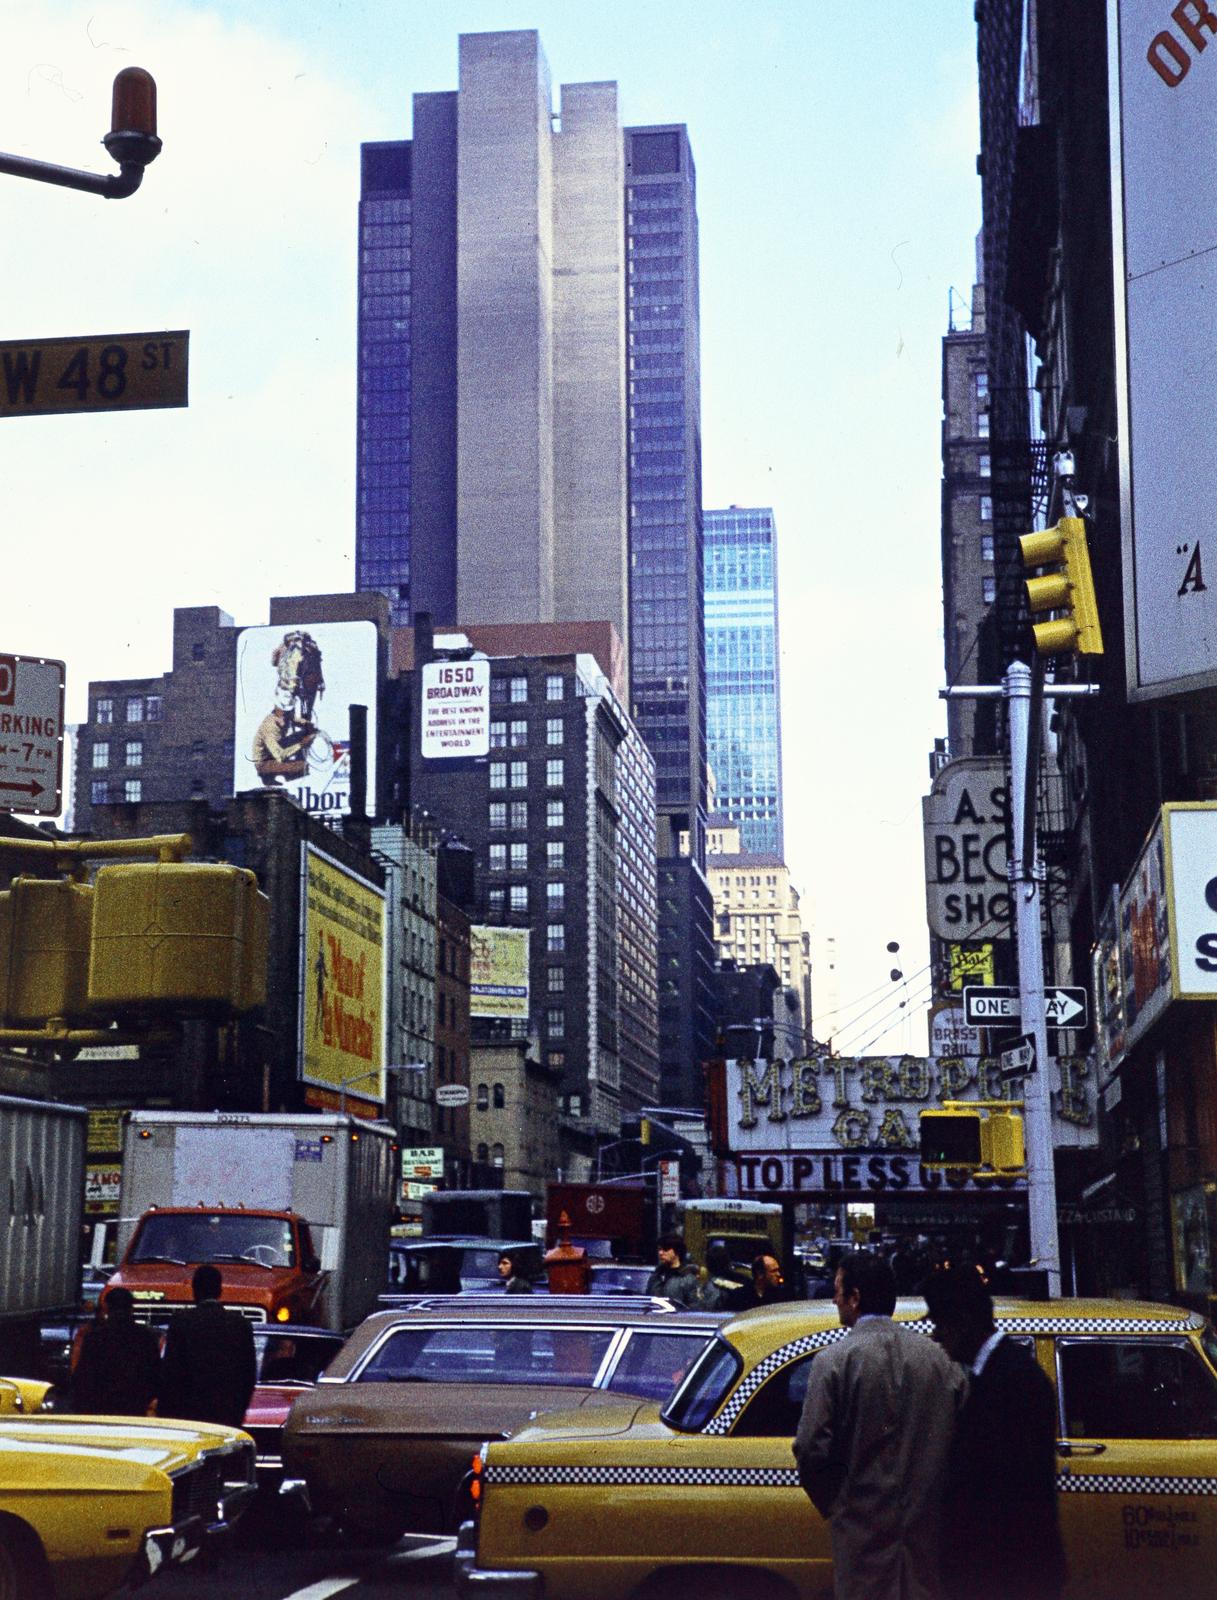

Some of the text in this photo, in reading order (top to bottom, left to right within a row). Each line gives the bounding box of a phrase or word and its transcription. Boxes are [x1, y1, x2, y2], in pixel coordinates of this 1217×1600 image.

[3, 341, 174, 405] W 48 ST
[439, 667, 474, 684] 1650
[427, 686, 484, 700] BROADWAY
[428, 706, 484, 715] THE BEST KNOWN
[427, 719, 456, 727] ADDRESS
[468, 717, 481, 725] THE
[426, 727, 485, 738] ENTERTAINMENT
[440, 739, 471, 748] WORLD
[297, 786, 347, 811] lbor
[935, 834, 1009, 884] BEC
[945, 893, 1012, 923] SHO
[976, 999, 1067, 1015] ONE AY
[934, 1027, 977, 1041] BRASS
[735, 1056, 1092, 1130] METROPOE
[832, 1109, 918, 1150] CA
[410, 1149, 435, 1157] BAR
[742, 1156, 911, 1190] TOPLESS
